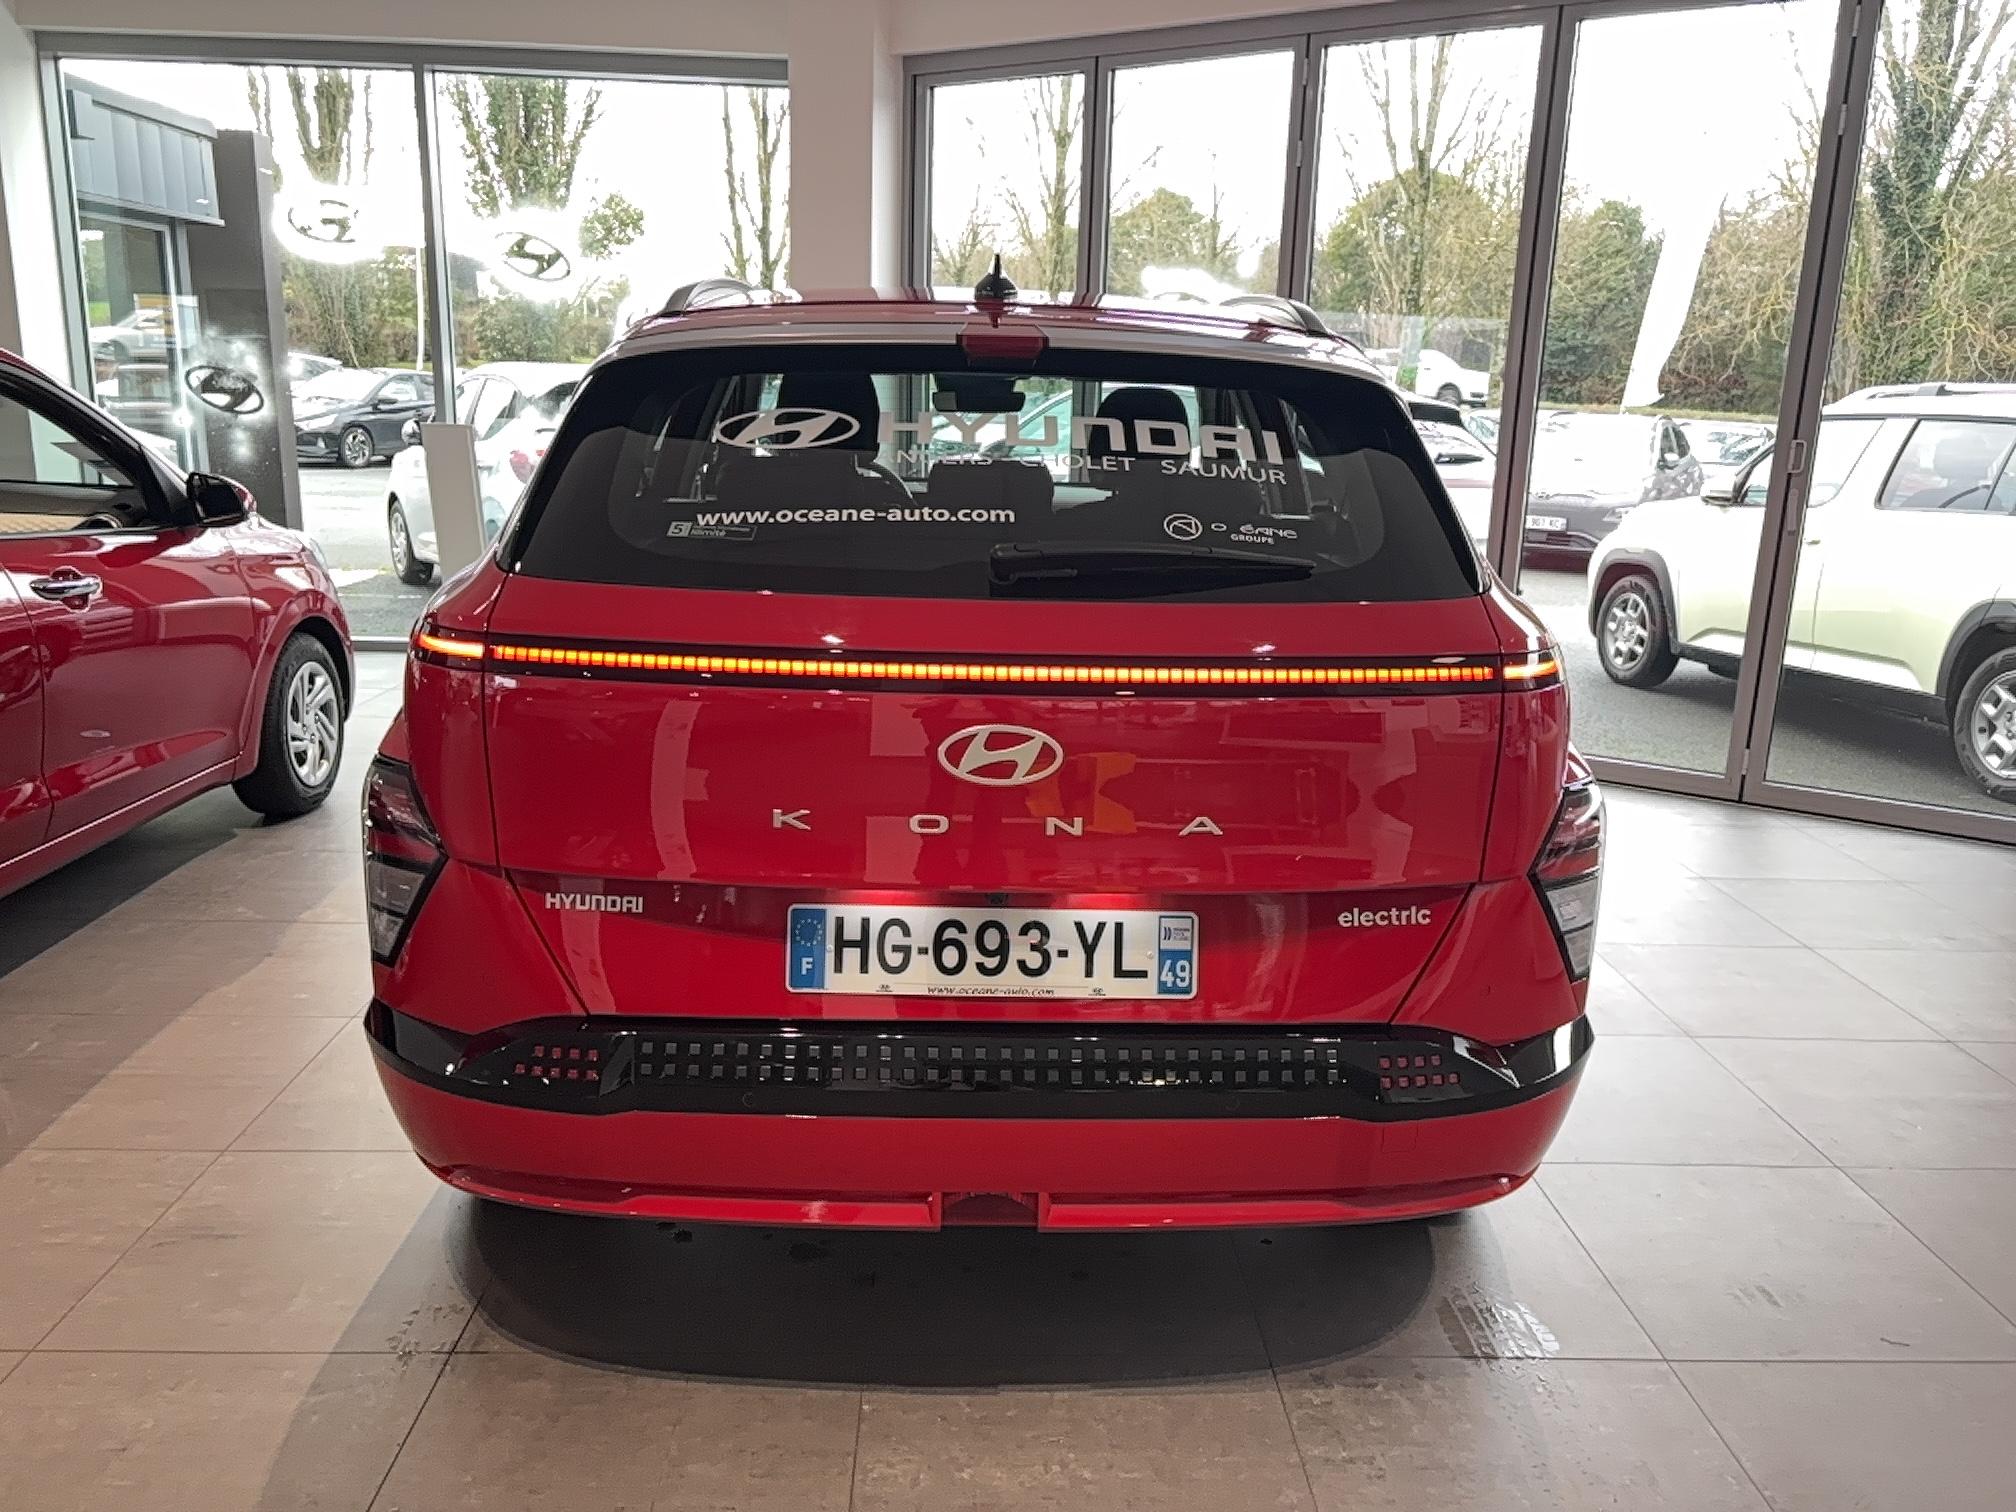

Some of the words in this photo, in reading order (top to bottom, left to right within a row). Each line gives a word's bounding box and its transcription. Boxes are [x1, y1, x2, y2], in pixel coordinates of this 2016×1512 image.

[877, 411, 1283, 465] HYUNDAI
[1161, 459, 1287, 485] SAUMUR
[696, 506, 1016, 526] www.oceane-auto.com
[1230, 533, 1275, 545] GROUPE
[544, 892, 644, 914] HYUNDAI
[1337, 905, 1432, 928] electric
[833, 915, 1149, 979] HG-693-YL
[801, 957, 814, 976] F
[1160, 959, 1191, 988] 49
[926, 985, 1055, 997] www.oceane-auto.com
